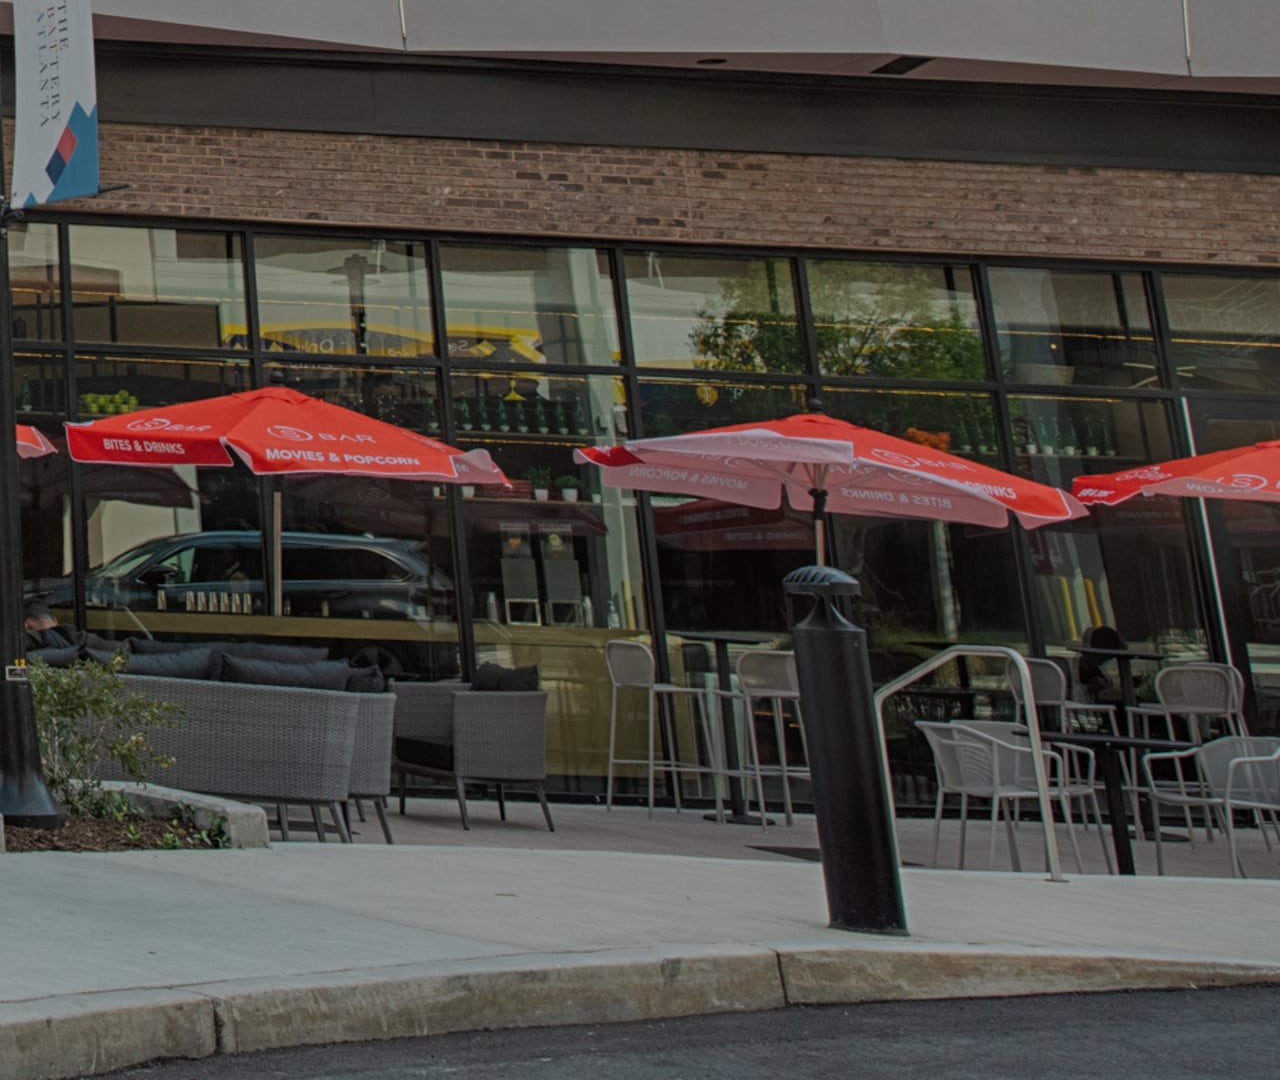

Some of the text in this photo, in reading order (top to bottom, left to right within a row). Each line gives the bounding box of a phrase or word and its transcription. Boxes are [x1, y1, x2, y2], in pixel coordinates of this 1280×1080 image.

[57, 0, 69, 53] THE
[36, 10, 50, 128] ATLANTA
[46, 5, 62, 124] BATTERY
[102, 438, 186, 455] BITES & DRINKS
[265, 448, 421, 466] MOVIES & POPCORN
